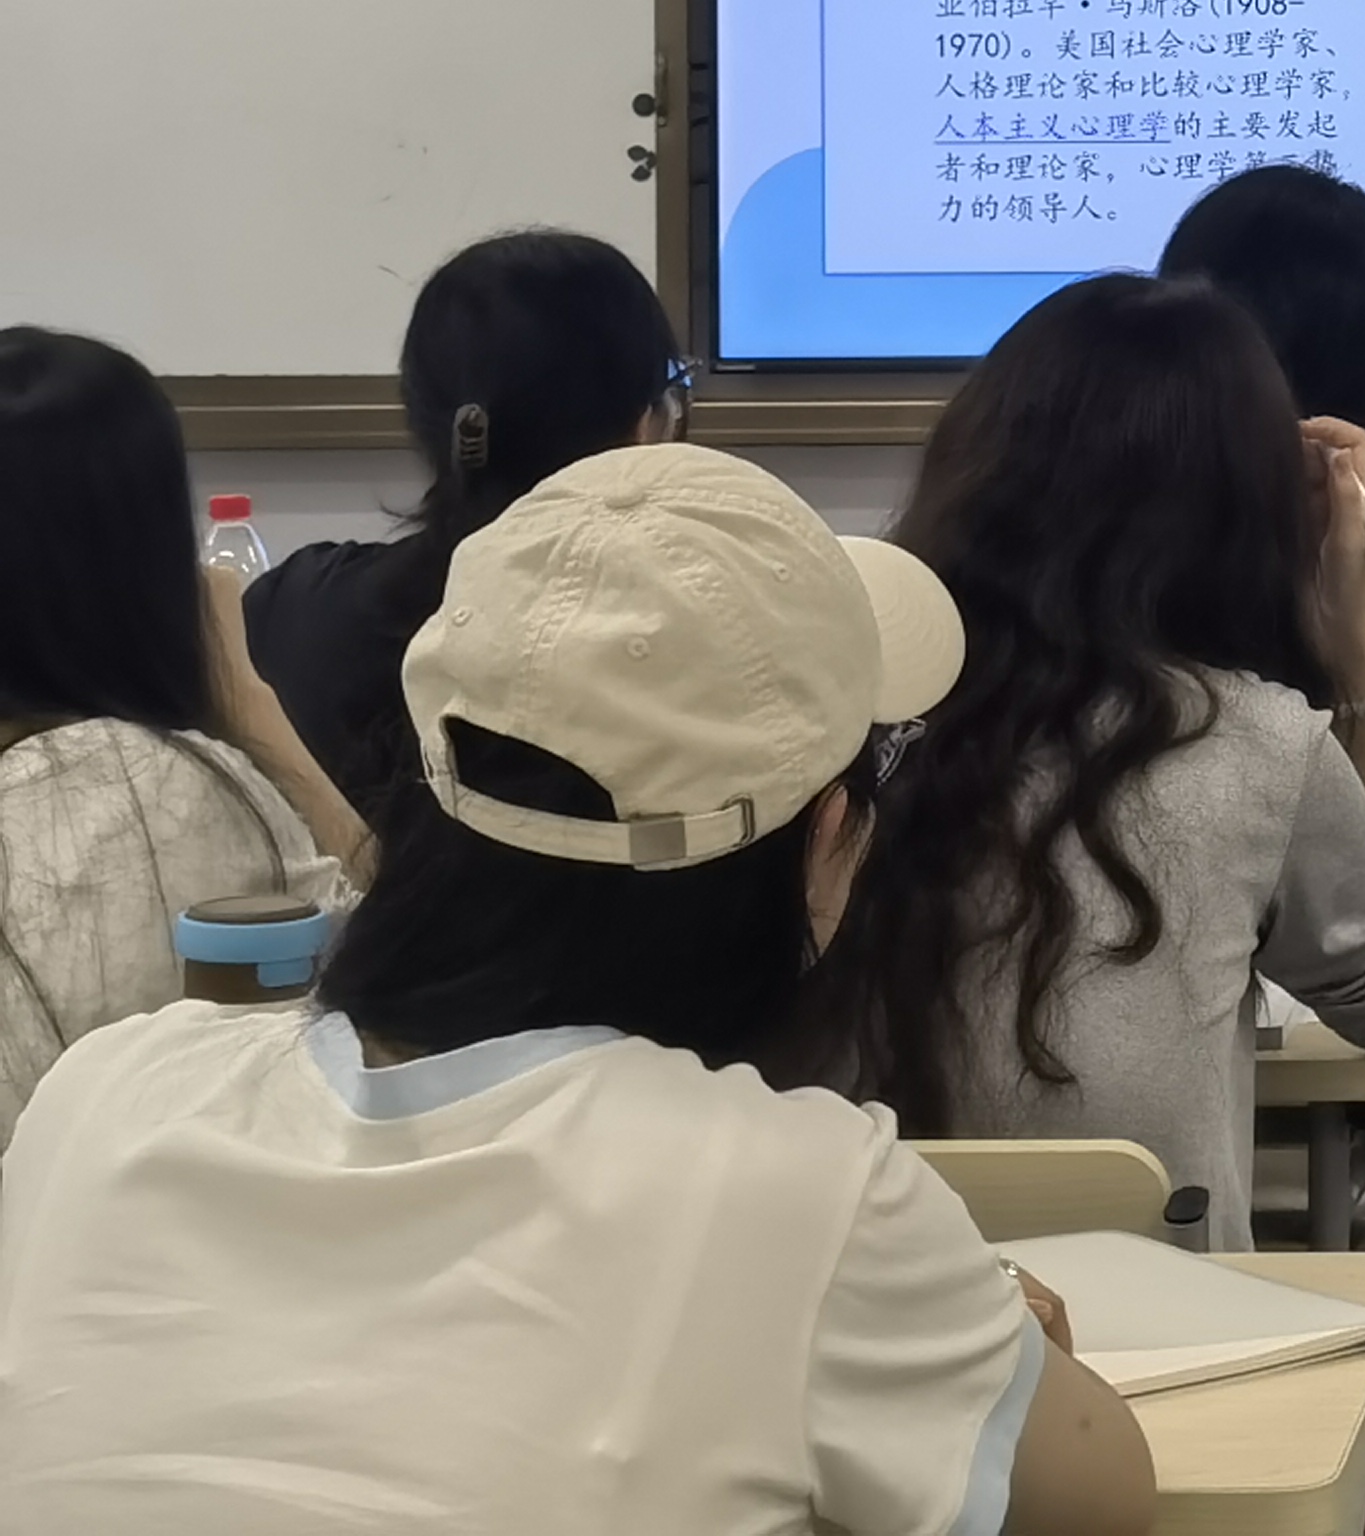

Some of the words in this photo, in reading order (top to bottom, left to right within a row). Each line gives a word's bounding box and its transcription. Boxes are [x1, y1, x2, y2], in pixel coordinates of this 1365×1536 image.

[935, 109, 1339, 141] 人本主义心理学的主要发起
